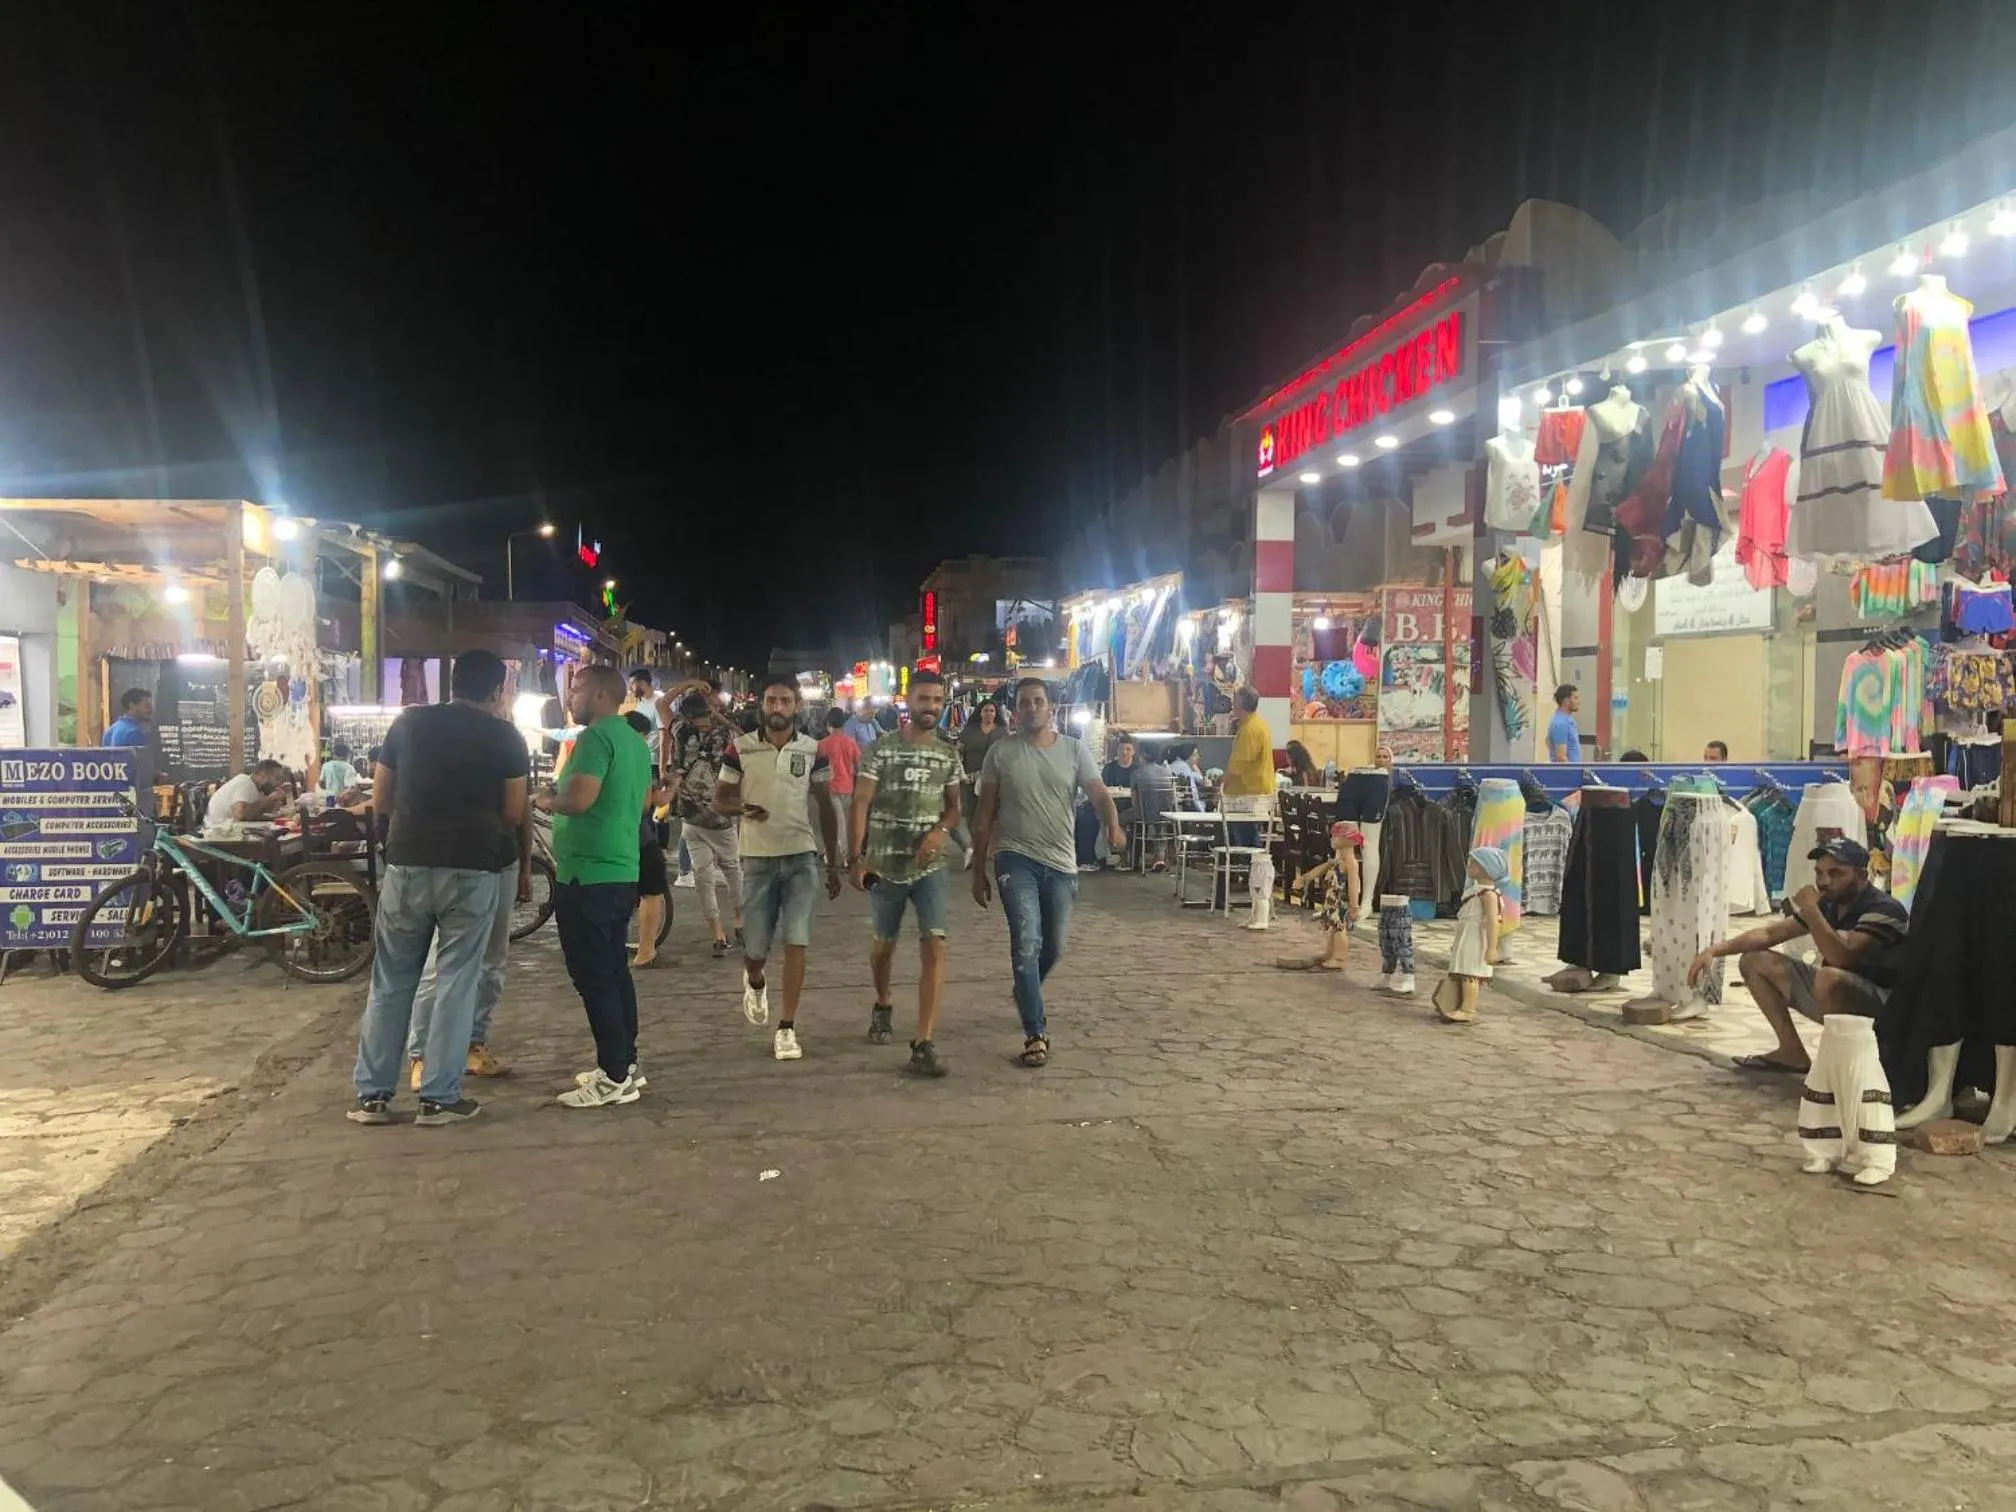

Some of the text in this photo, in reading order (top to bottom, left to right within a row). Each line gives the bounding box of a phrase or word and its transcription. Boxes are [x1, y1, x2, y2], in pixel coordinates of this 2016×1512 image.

[1275, 311, 1460, 468] KING CHICKEN
[1412, 593, 1445, 606] KING
[5, 761, 129, 781] MEZO BOOK
[904, 767, 931, 782] OFF
[2, 795, 37, 805] MOBILES
[48, 794, 90, 805] COMPUTER
[45, 820, 132, 830] COMPUTER ACCESSORIES
[4, 844, 90, 855] ACCESSORIES MOBILE PHONES
[48, 867, 85, 877] SOFTWARE
[92, 866, 132, 876] HARDWARE
[8, 887, 82, 900] CHARGE CARD
